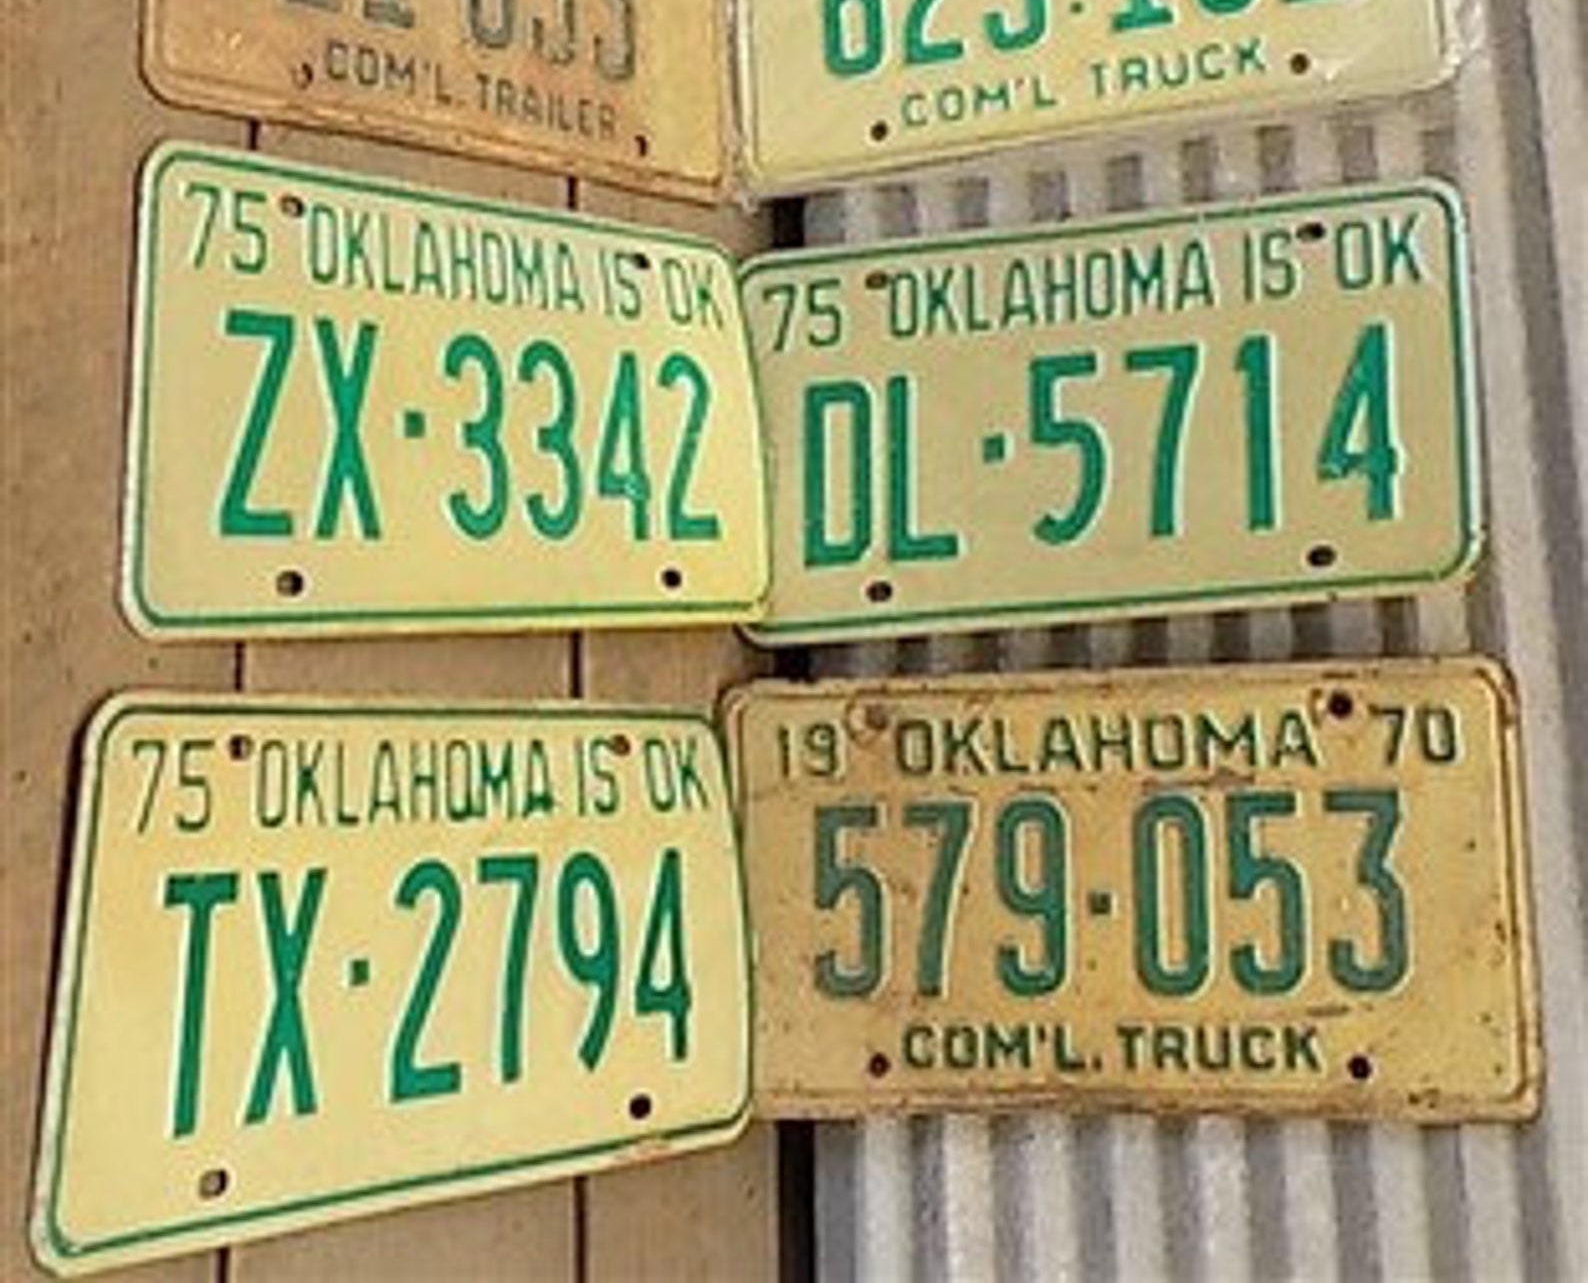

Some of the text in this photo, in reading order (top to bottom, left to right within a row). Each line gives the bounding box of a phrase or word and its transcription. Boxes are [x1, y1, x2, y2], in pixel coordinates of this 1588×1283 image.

[475, 72, 616, 139] TRAILER
[1089, 39, 1269, 99] TRUCK
[185, 182, 724, 330] 75 OKLAHOMA IS OK
[761, 215, 1423, 353] 75 OKLAHOMA IS OK
[777, 705, 1460, 778] 19 OKLAHOMA 70
[132, 735, 710, 835] 75 OKLAHOMA IS OK
[1116, 1024, 1321, 1073] TRUCK
